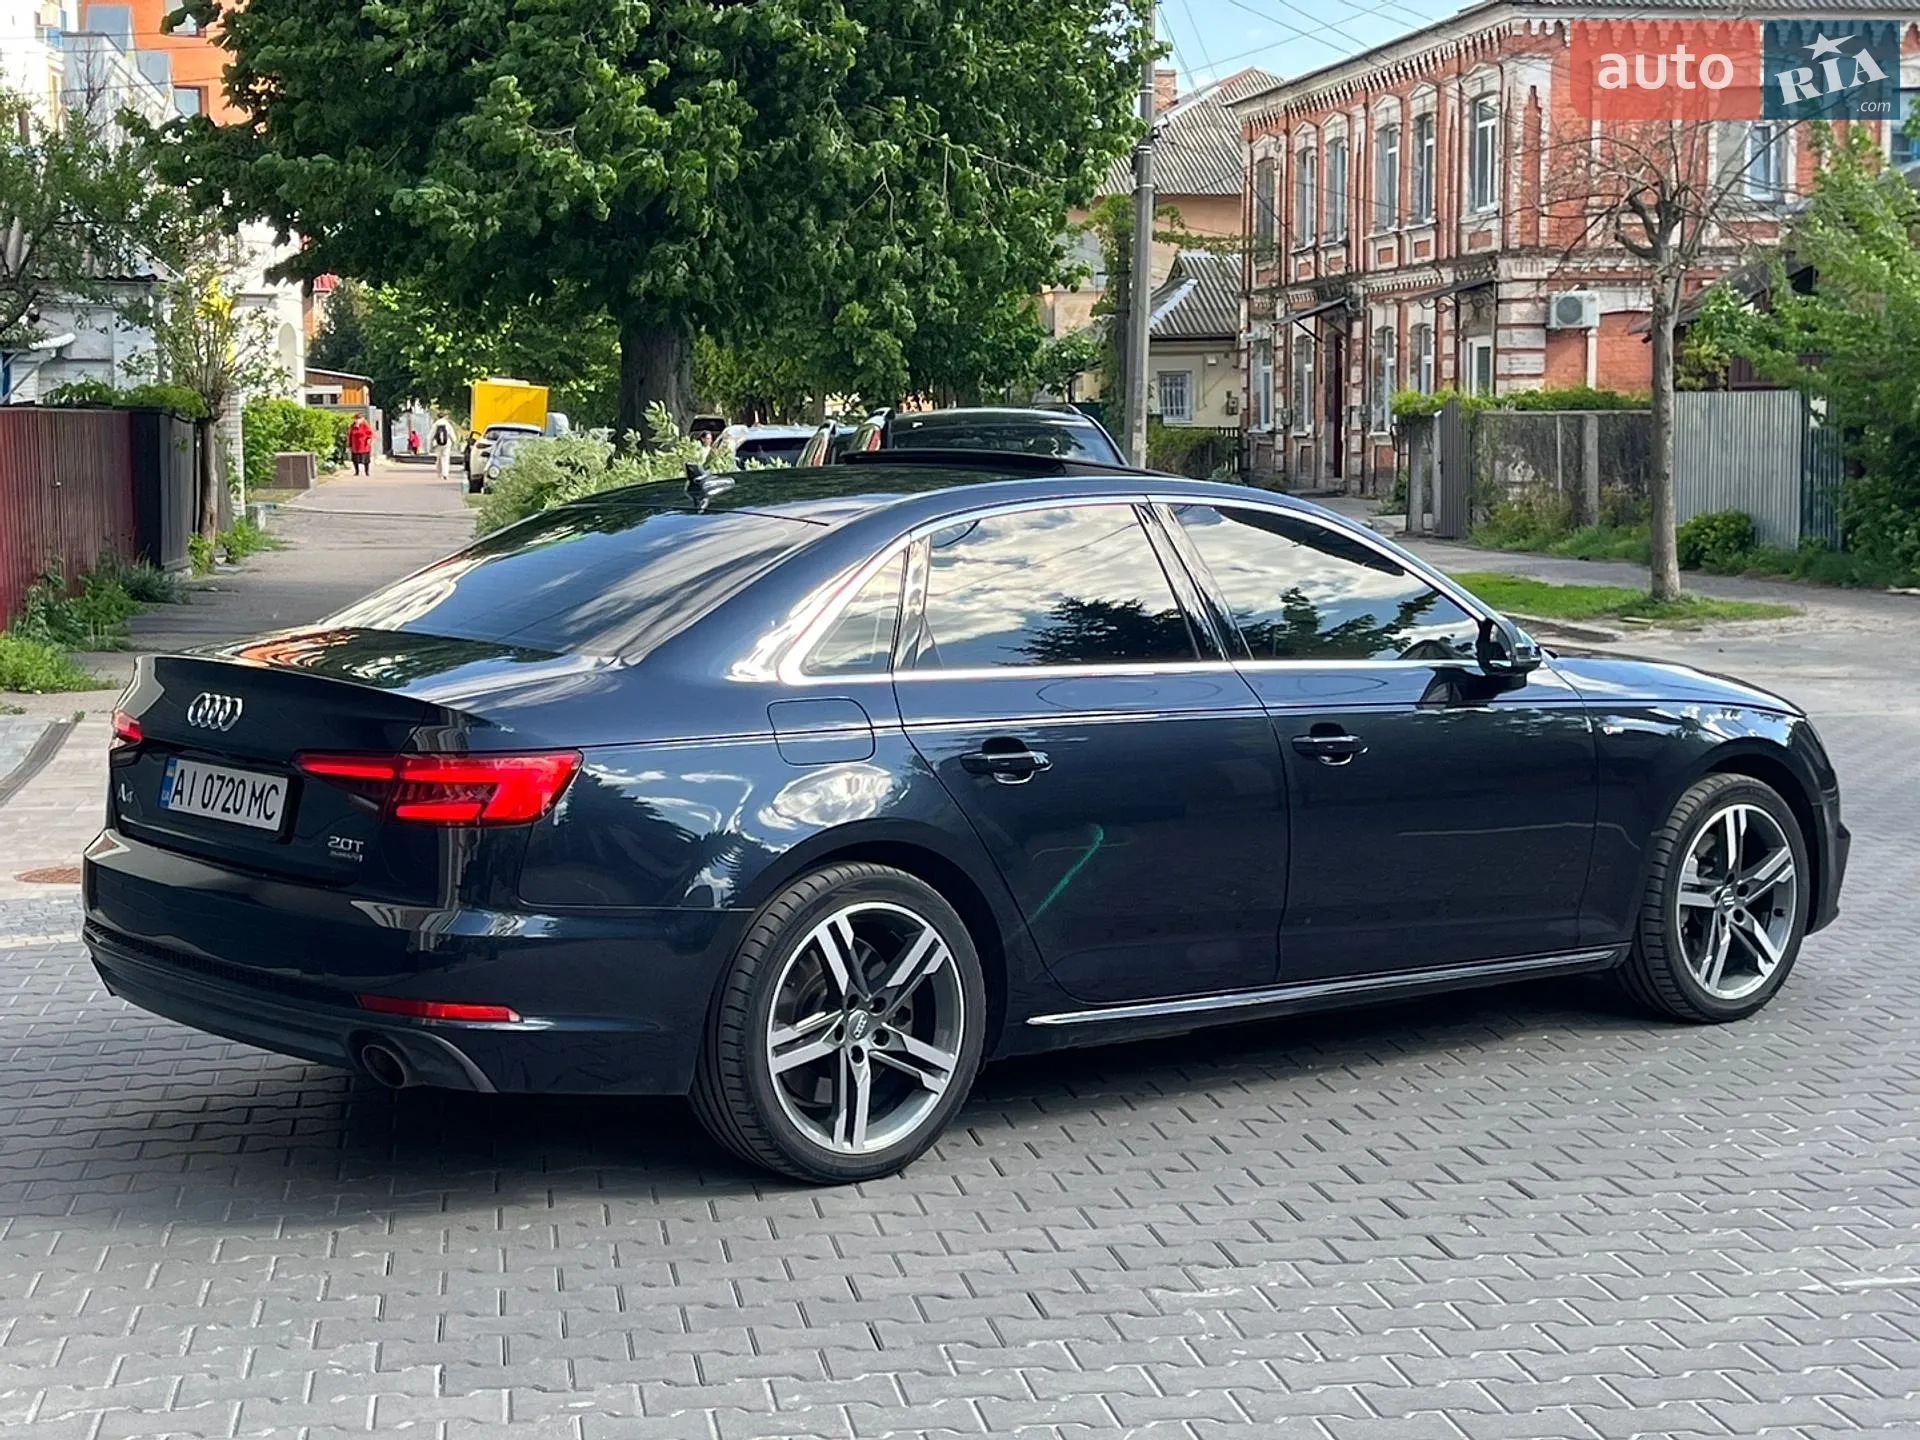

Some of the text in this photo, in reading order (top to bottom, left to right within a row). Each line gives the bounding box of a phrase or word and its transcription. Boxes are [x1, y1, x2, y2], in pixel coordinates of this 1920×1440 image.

[170, 768, 280, 821] AI 0720 MC
